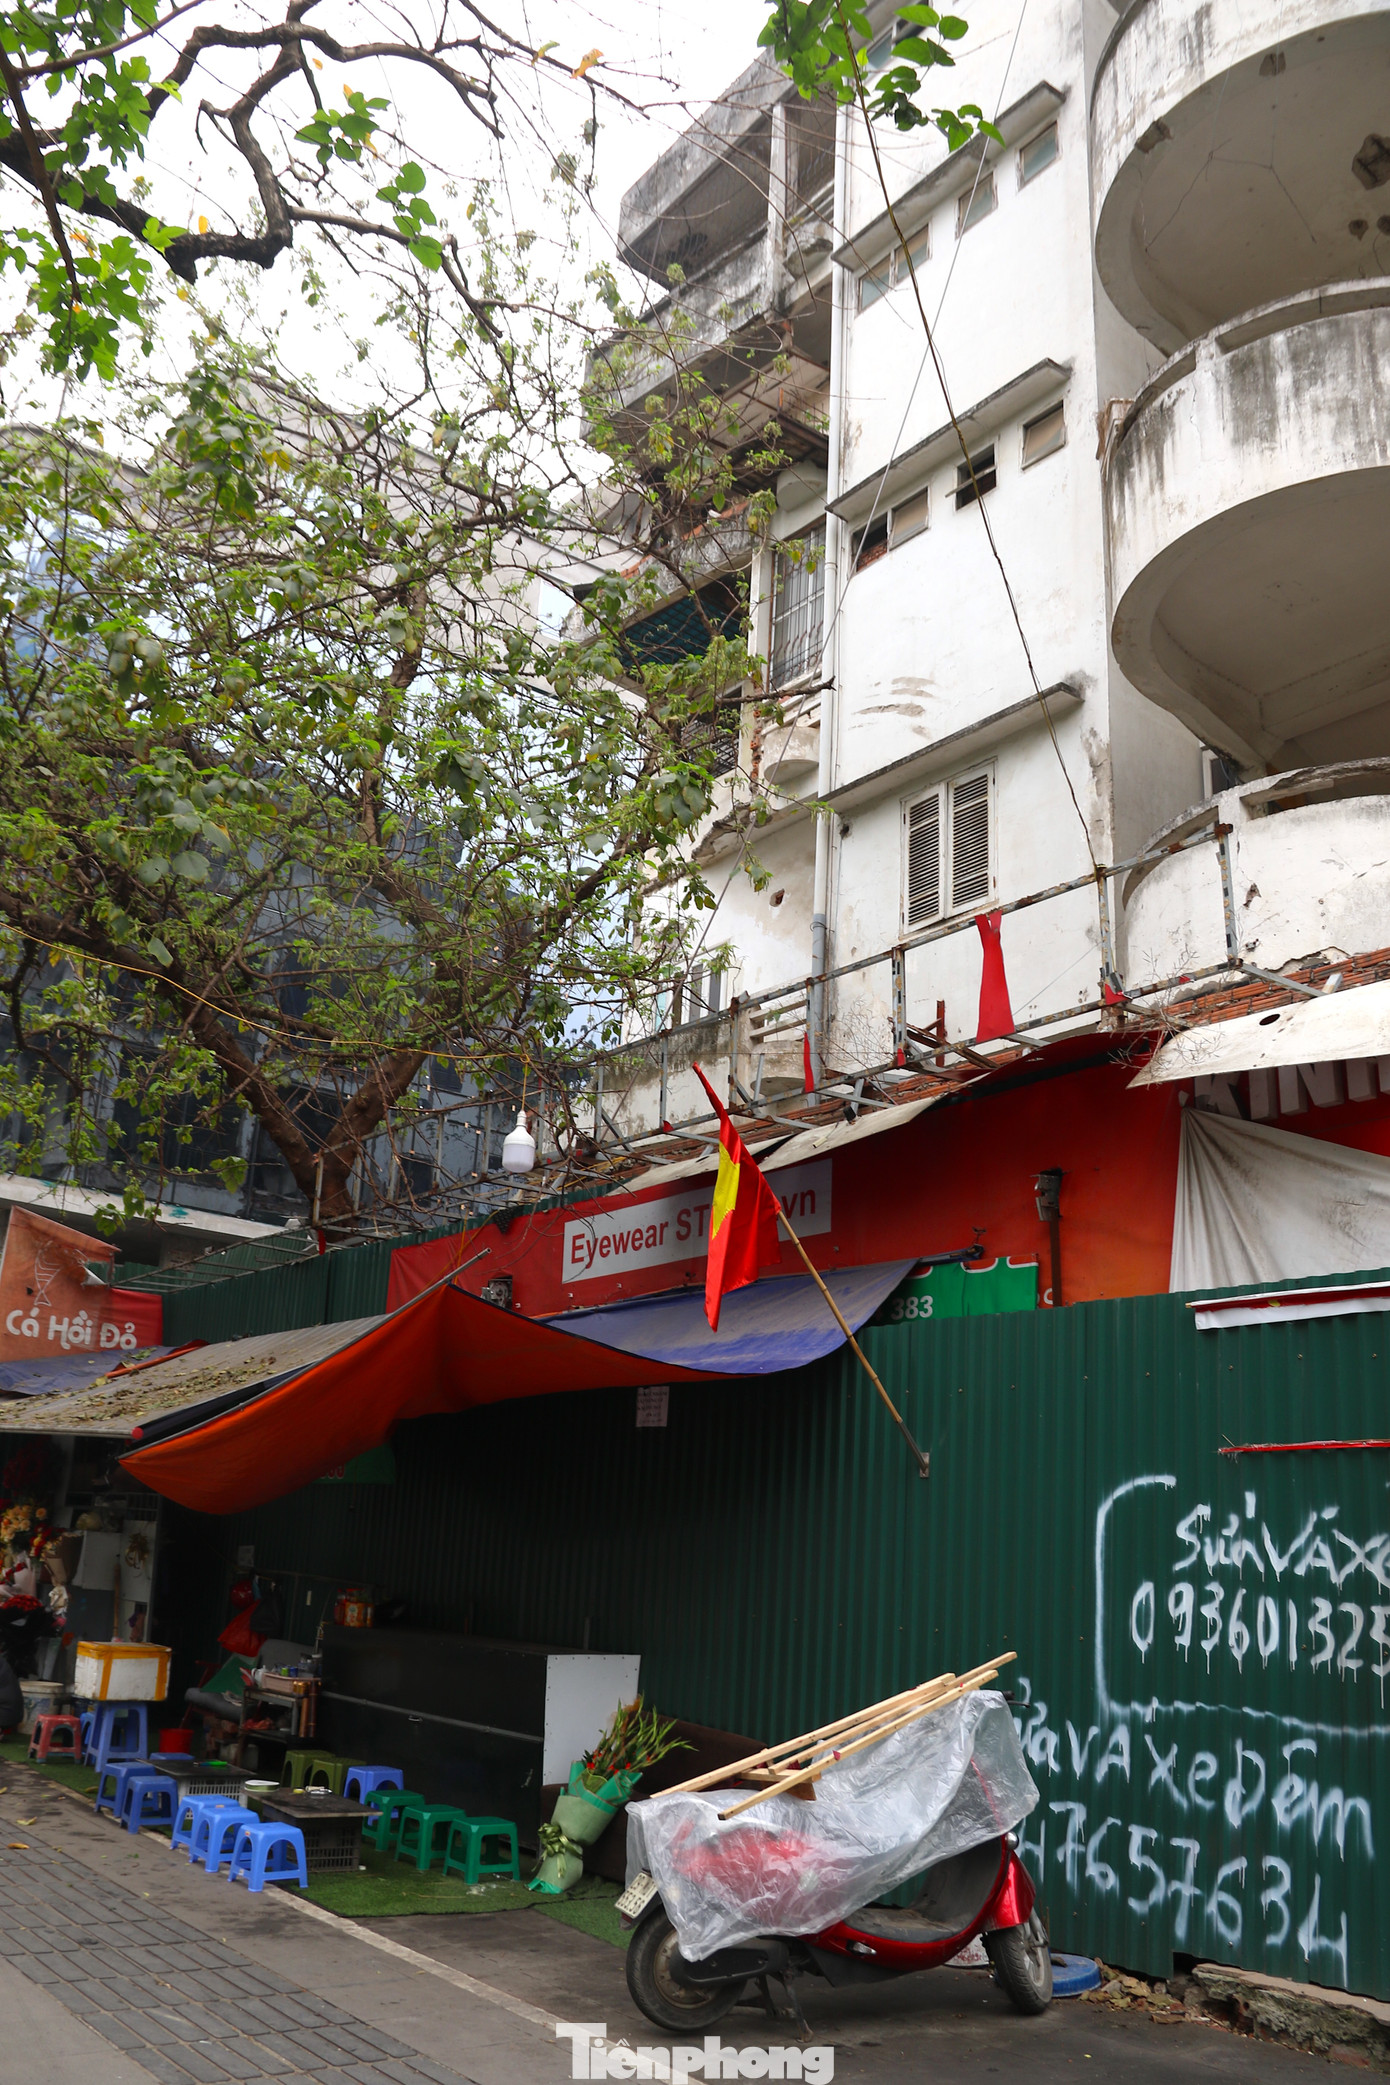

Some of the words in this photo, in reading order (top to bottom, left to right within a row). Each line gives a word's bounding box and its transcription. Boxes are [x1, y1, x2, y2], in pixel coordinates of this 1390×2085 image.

[571, 1221, 668, 1270] Eyewear
[6, 1307, 40, 1338] Cá
[47, 1310, 93, 1350] Hồi
[100, 1322, 137, 1350] Đỏ
[890, 1295, 934, 1320] 383
